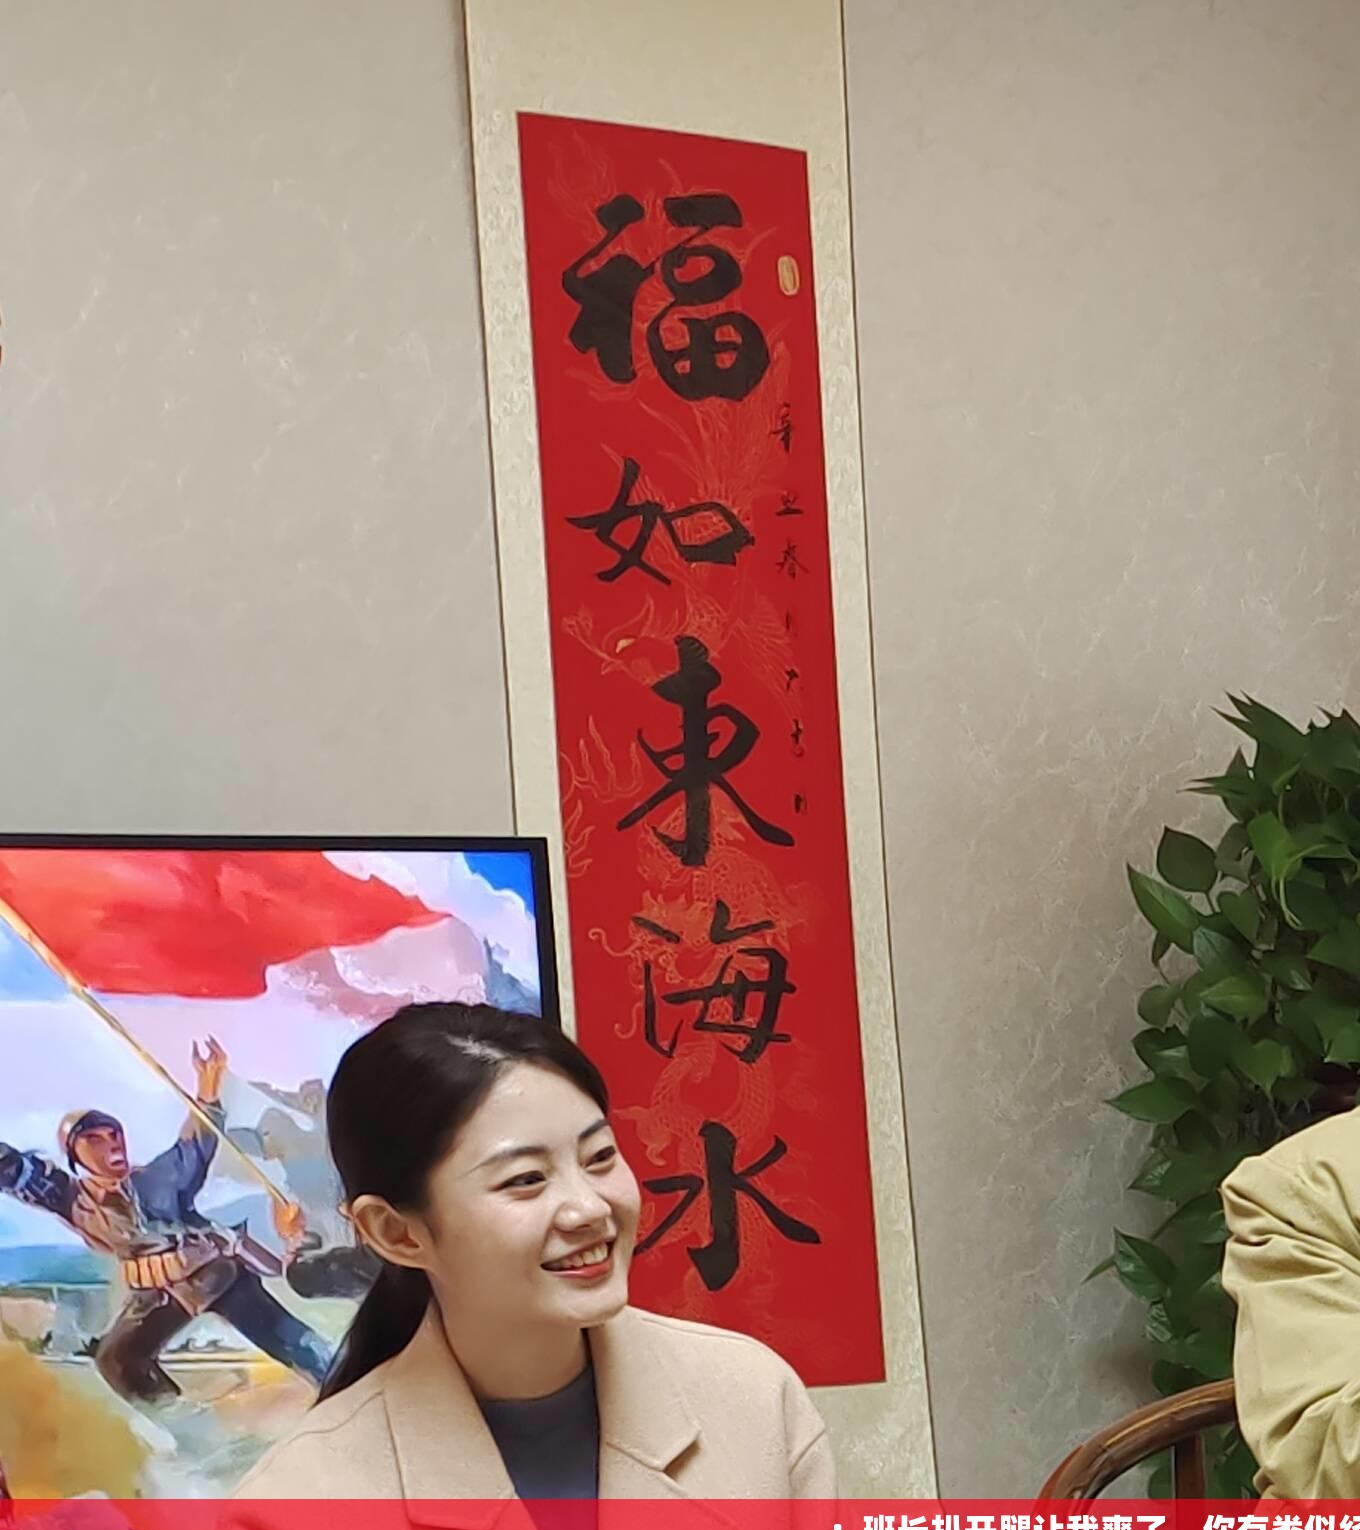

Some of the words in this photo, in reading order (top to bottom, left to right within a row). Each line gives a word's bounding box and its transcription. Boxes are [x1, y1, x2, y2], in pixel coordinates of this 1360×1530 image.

[560, 193, 822, 1293] 福如東海水
